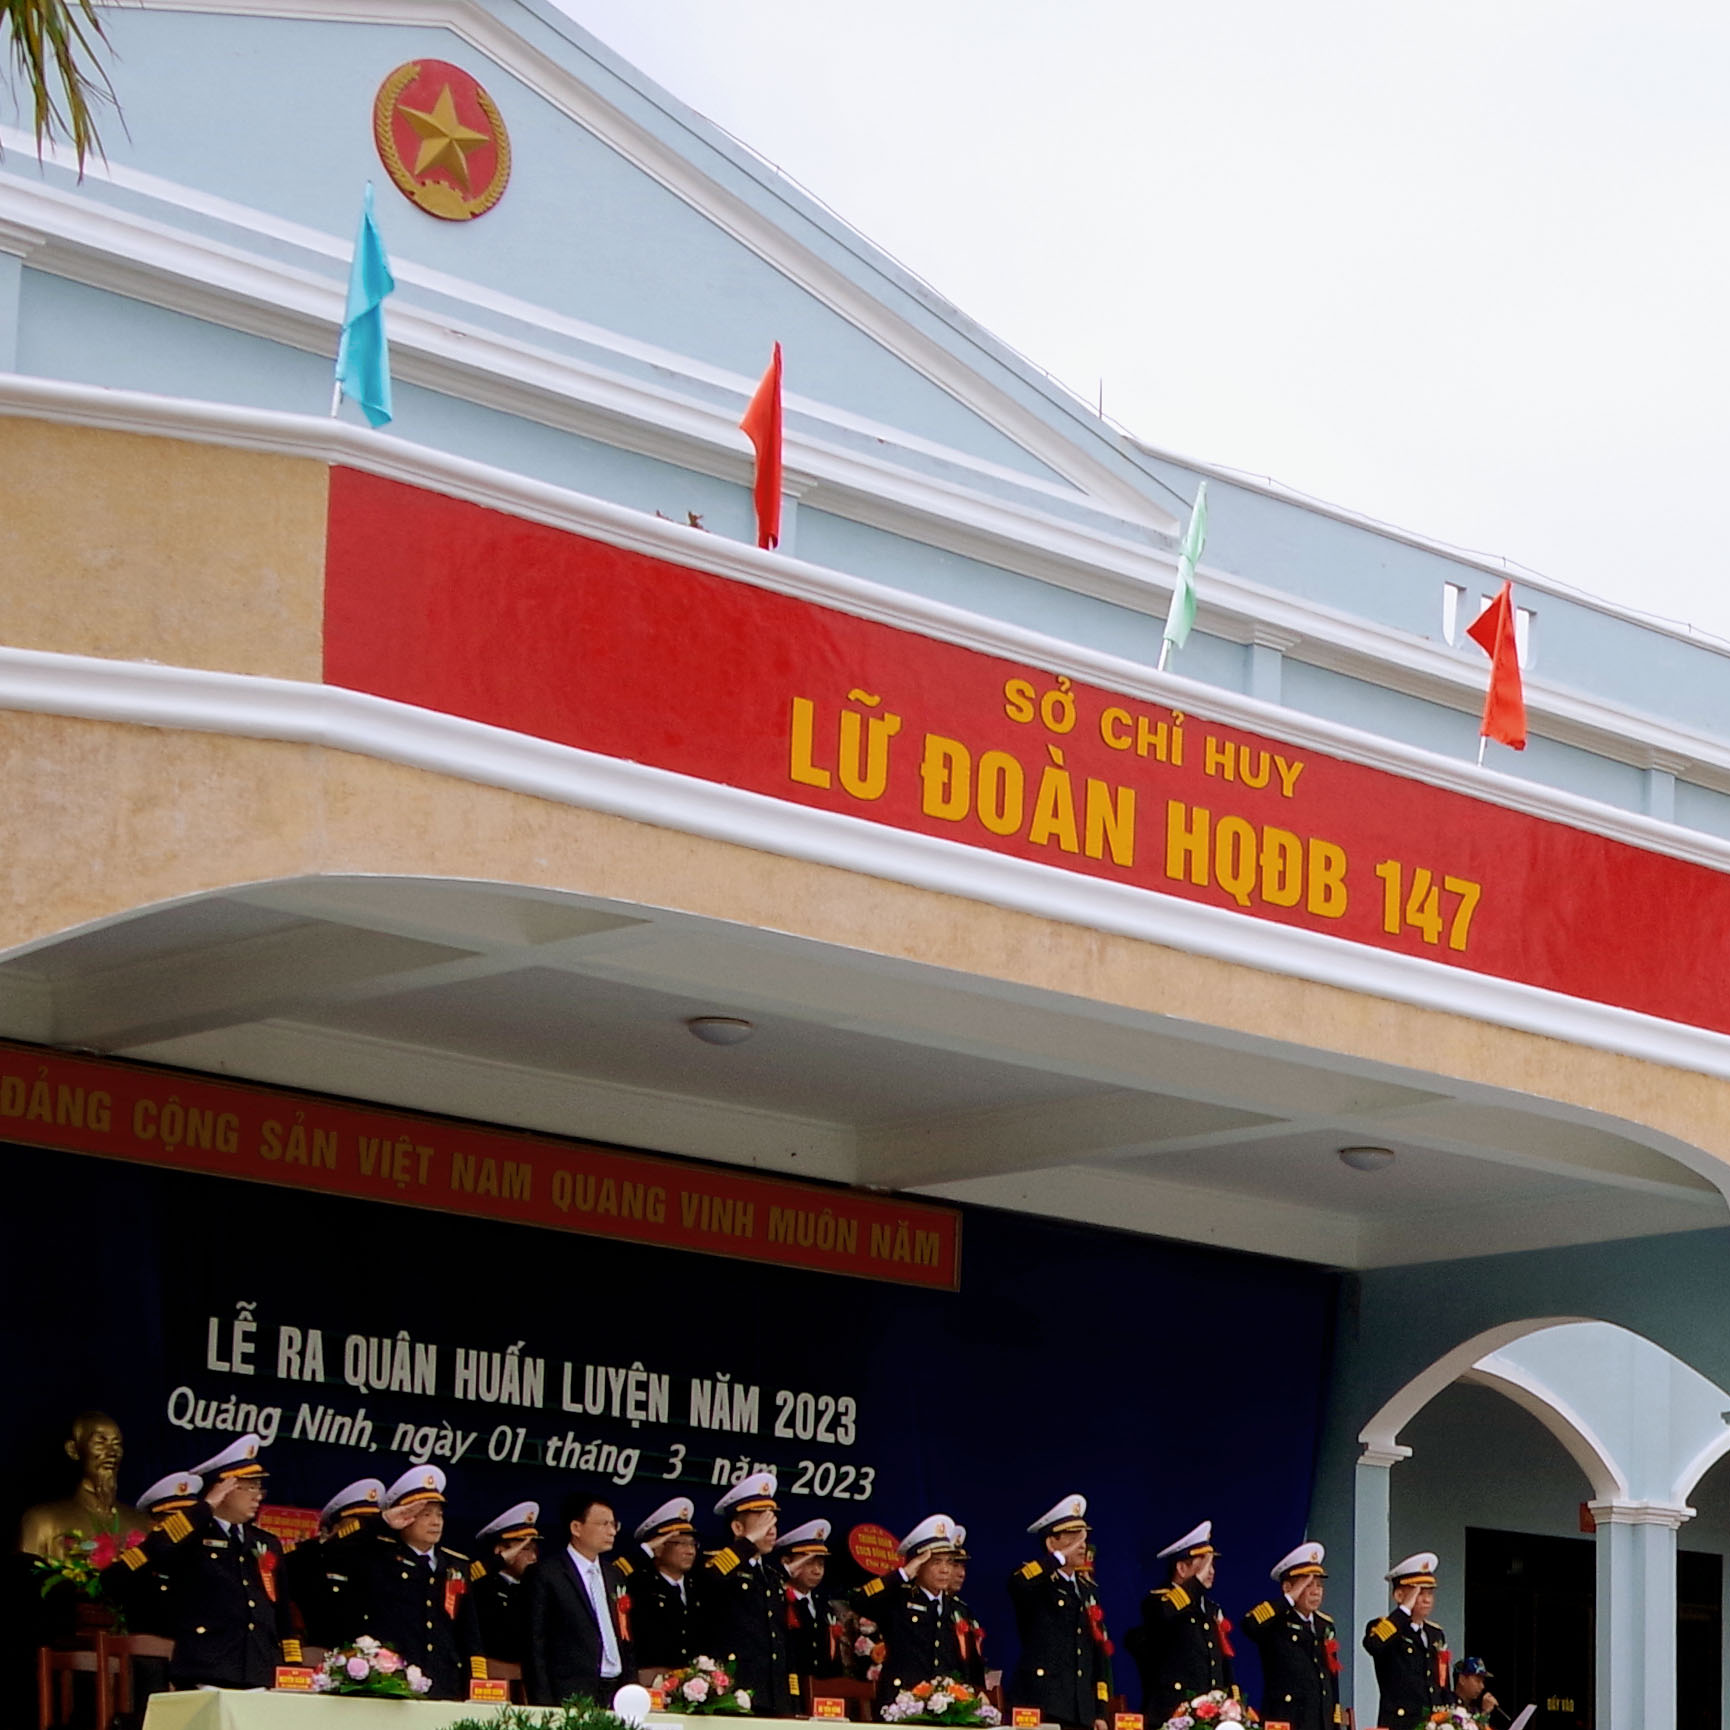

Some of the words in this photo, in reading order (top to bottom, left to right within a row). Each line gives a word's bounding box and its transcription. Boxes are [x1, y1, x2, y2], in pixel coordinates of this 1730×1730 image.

[1003, 676, 1078, 734] SỞ
[1100, 706, 1185, 767] CHỈ
[1204, 735, 1305, 798] HUY
[790, 688, 901, 801] LỮ
[920, 732, 1136, 868] ĐOÀN
[1165, 799, 1348, 919] HQĐB
[1375, 859, 1482, 952] 147
[0, 1064, 112, 1133] ĐẢNG
[132, 1094, 240, 1154] CỘNG
[259, 1110, 338, 1170] SẢN
[358, 1135, 435, 1189] VIỆT
[450, 1151, 533, 1201] NAM
[551, 1169, 666, 1223] QUANG
[680, 1190, 755, 1238] VINH
[768, 1206, 859, 1255] MUÔN
[869, 1214, 940, 1267] NĂM
[167, 1386, 282, 1447] Quảng
[291, 1402, 378, 1453] Ninh,
[390, 1419, 478, 1464] ngày
[488, 1425, 527, 1463] 01
[545, 1431, 641, 1485] tháng
[663, 1443, 687, 1480] 3
[790, 1460, 876, 1501] 2023
[206, 1300, 258, 1375] LỄ
[276, 1325, 325, 1383] RA
[343, 1330, 438, 1396] QUÂN
[454, 1340, 545, 1408] HUẤN
[561, 1361, 670, 1428] LUYỆN
[689, 1371, 760, 1434] NĂM
[774, 1389, 857, 1446] 2023
